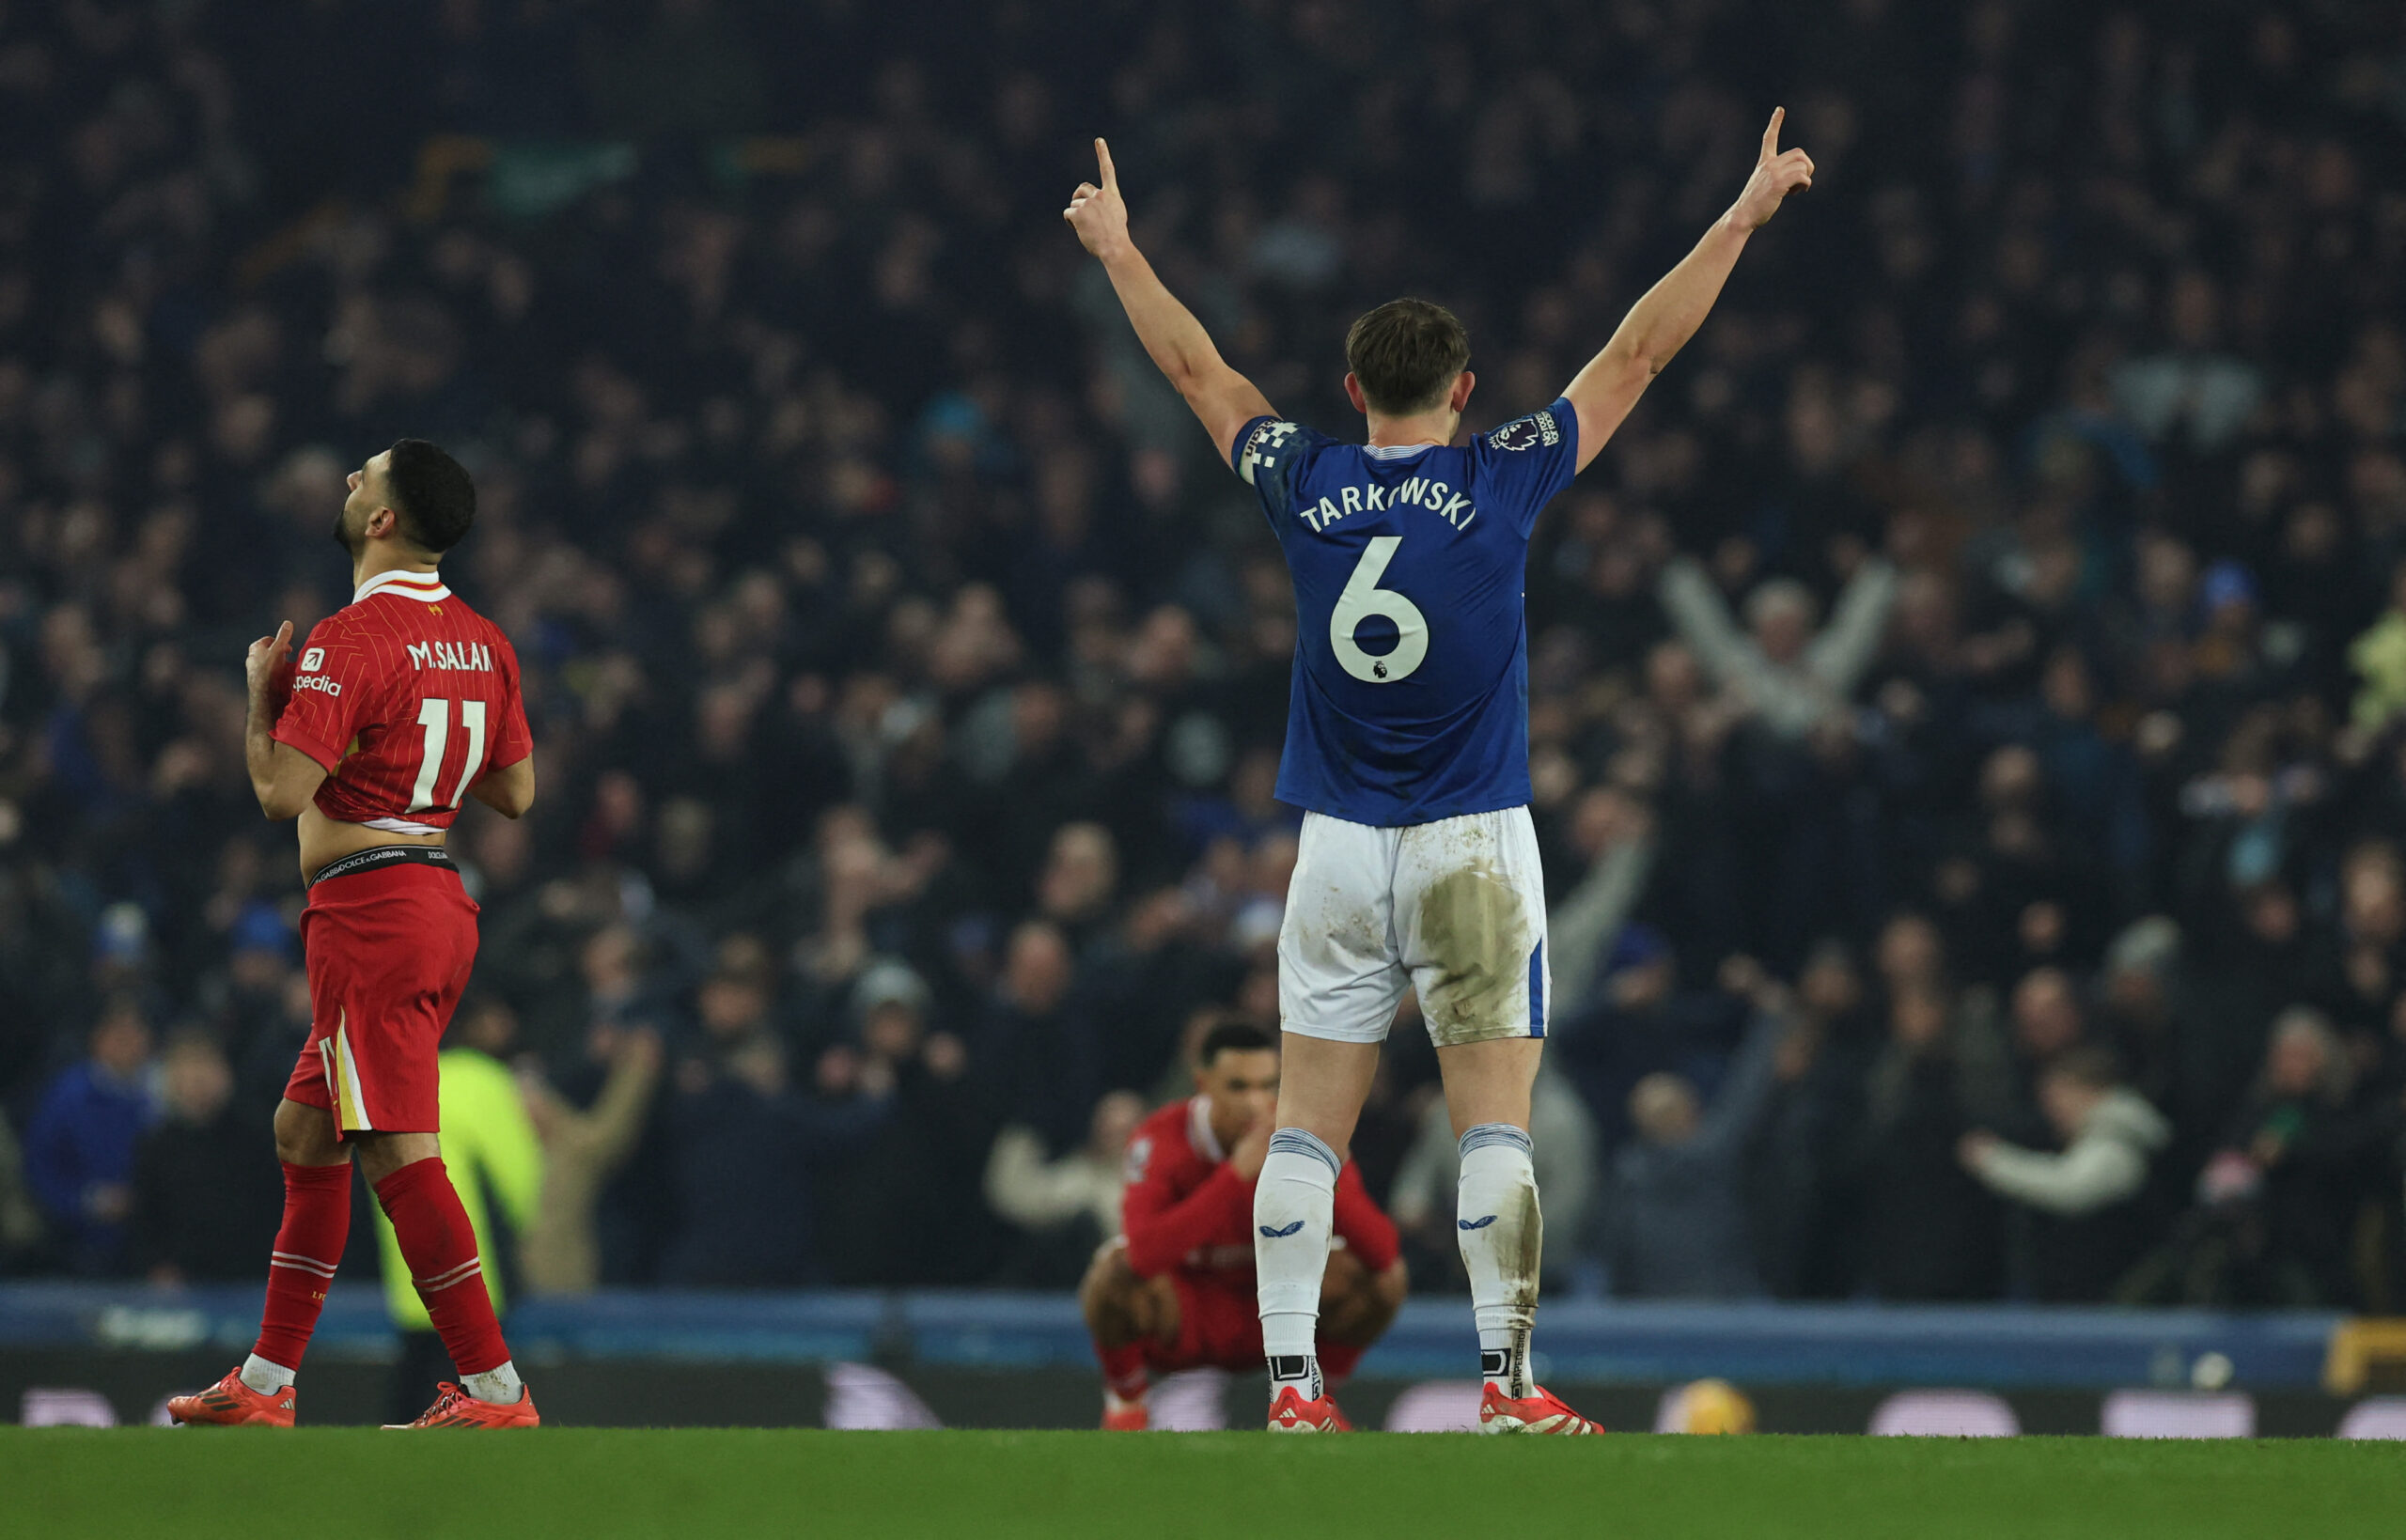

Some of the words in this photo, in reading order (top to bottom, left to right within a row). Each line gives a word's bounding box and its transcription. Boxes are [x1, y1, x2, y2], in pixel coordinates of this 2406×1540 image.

[1330, 537, 1430, 684] 6
[293, 675, 342, 697] pedia
[404, 698, 486, 815] 11
